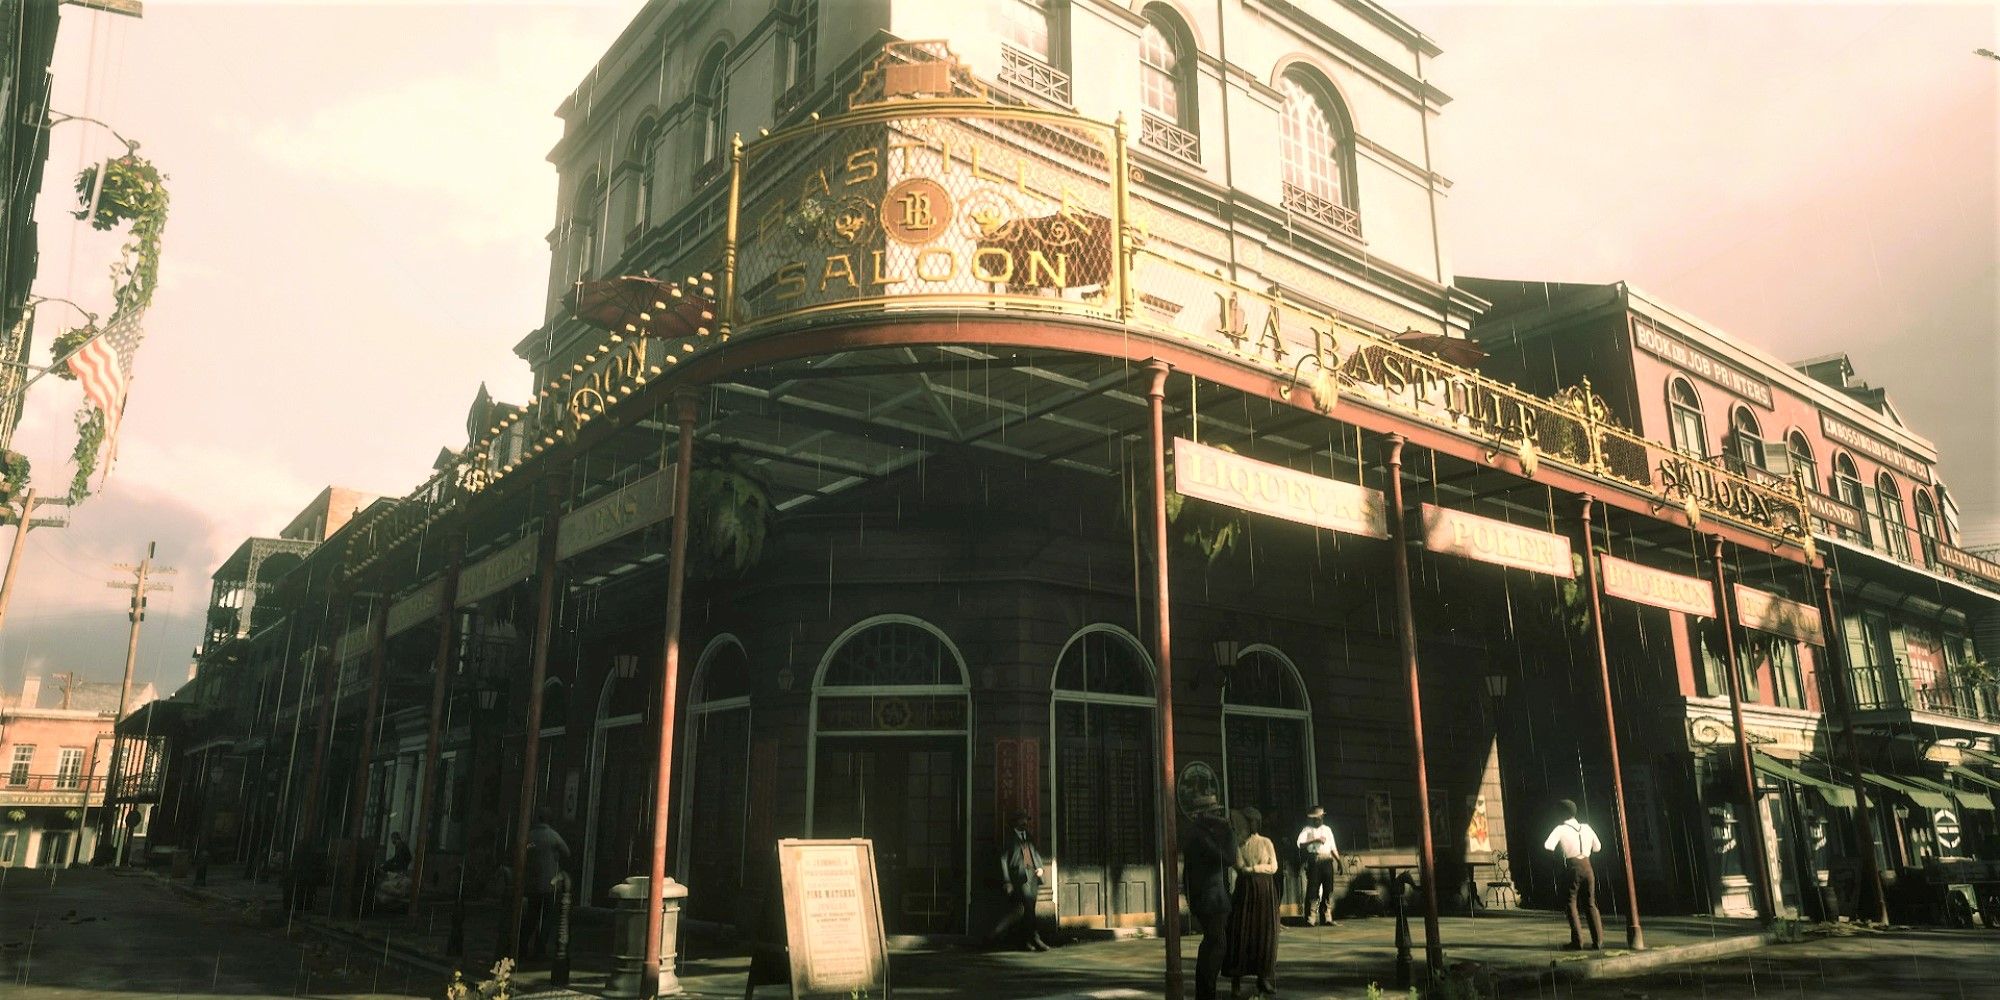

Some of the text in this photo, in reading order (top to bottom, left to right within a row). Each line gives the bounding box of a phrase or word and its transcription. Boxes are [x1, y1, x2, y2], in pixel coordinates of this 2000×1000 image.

[776, 247, 1068, 301] SALOON
[1214, 290, 1540, 442] LA BASTILLE
[1636, 324, 1673, 358] BOOK
[1688, 351, 1711, 375] JOB
[1658, 456, 1772, 528] SALOON
[1808, 493, 1854, 525] WAGNER
[1449, 517, 1556, 567] POKER
[1608, 562, 1710, 609] BOURBON
